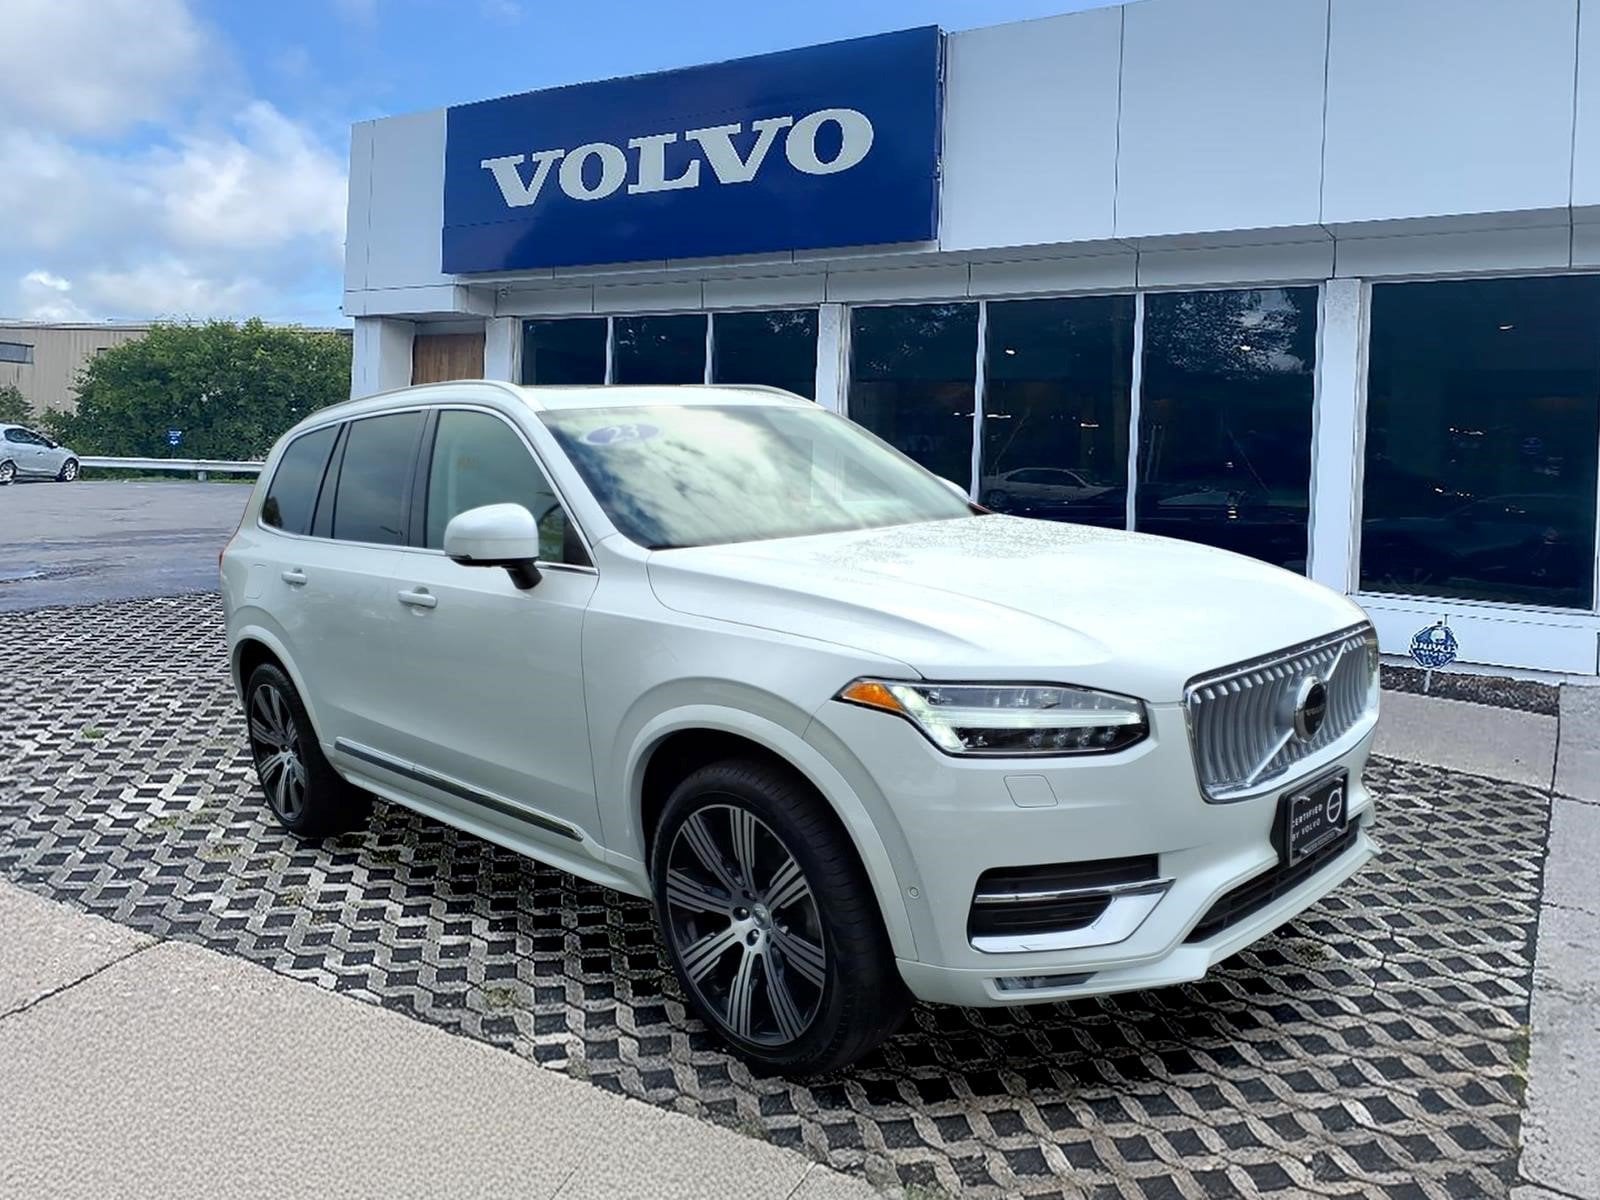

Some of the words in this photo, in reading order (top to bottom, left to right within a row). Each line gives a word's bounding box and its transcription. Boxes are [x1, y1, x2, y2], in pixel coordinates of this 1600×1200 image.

[481, 108, 874, 208] VOLVO
[1291, 803, 1323, 828] CERTIFIED
[1301, 817, 1321, 835] VOLVO
